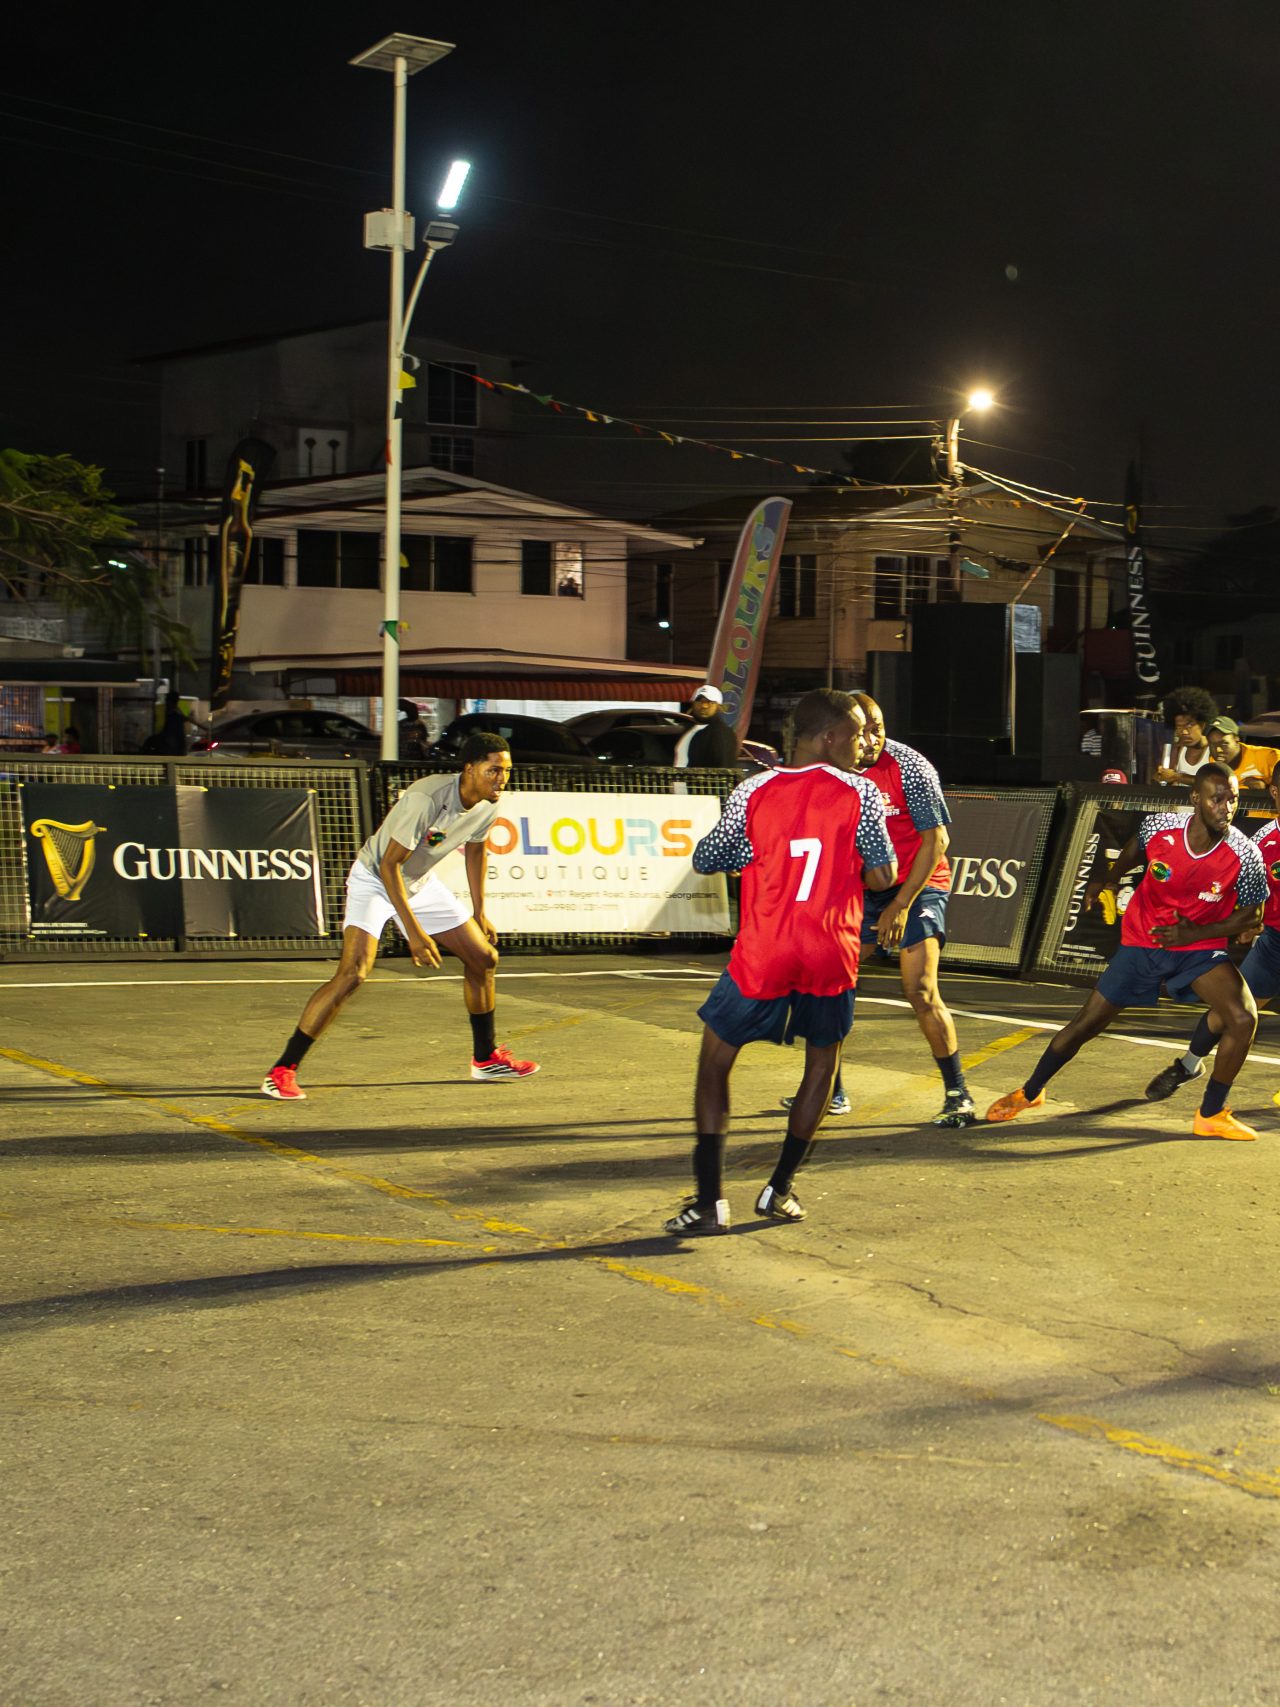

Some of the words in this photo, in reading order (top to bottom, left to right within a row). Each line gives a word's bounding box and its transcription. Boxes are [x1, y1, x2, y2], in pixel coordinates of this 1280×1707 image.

[716, 520, 776, 727] OLOURS
[1129, 546, 1160, 683] GUINNESS
[113, 842, 313, 881] GUINNESS
[485, 816, 693, 857] OLOURS
[488, 865, 648, 880] BOUTIQUE
[789, 838, 822, 902] 7
[1063, 833, 1100, 932] GUINNESS
